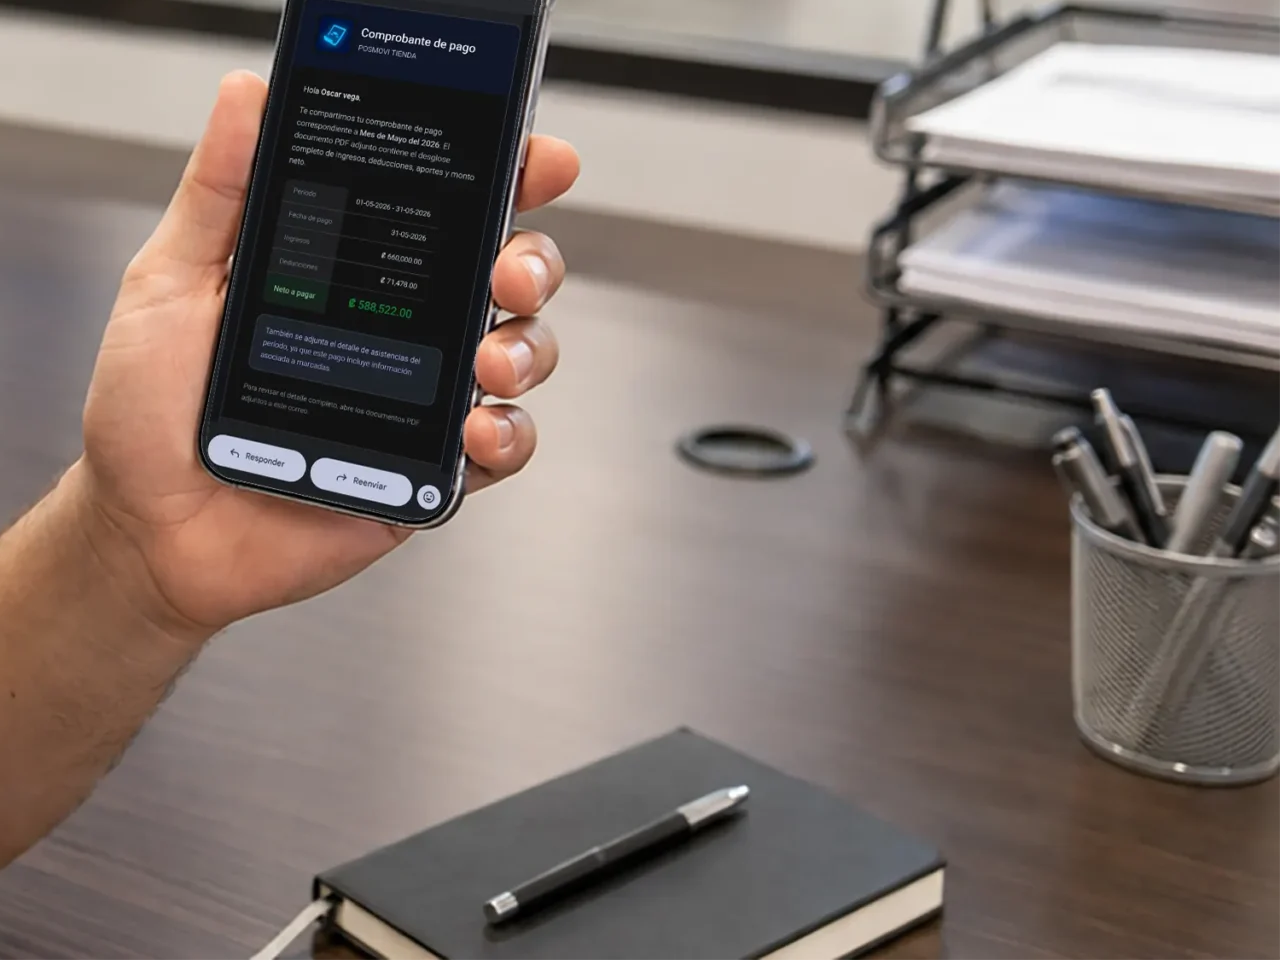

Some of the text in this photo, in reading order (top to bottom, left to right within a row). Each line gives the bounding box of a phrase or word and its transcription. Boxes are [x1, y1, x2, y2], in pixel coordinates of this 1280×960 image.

[361, 28, 476, 55] Comprobante de pago
[358, 44, 417, 59] POSMOVI TIENDA
[303, 85, 320, 95] Hola
[321, 88, 342, 99] Oscar
[300, 106, 443, 137] Te compartimos tu comprobante de pago
[296, 120, 353, 135] correspondiente
[359, 129, 375, 139] Mes
[376, 132, 386, 140] de
[387, 134, 407, 145] Mayo
[408, 137, 420, 146] del
[443, 142, 451, 150] El
[294, 132, 451, 164] documento PDF adjunto contiene el desglose
[291, 144, 475, 181] completo de ingresos, deducciones, aportes y monto
[355, 198, 390, 210] 01-05-2026
[395, 205, 431, 218] 31-05-2026
[316, 216, 333, 225] pago
[391, 229, 427, 242] 31-05-2026
[273, 285, 289, 295] Neto
[296, 290, 316, 300] pagar
[357, 300, 412, 319] 588,522.00
[260, 352, 290, 364] asociada
[304, 336, 329, 347] adjunta
[337, 342, 360, 352] detalle
[360, 346, 369, 355] de
[370, 349, 409, 363] asistencias
[409, 356, 421, 365] del
[290, 345, 298, 353] ya
[299, 348, 312, 356] que
[313, 350, 327, 359] este
[328, 353, 346, 363] pago
[346, 356, 370, 368] incluye
[371, 361, 412, 376] información
[243, 382, 258, 392] Para
[258, 385, 279, 396] revisar
[286, 392, 307, 402] detalle
[339, 404, 354, 413] abre
[355, 407, 364, 415] los
[365, 410, 406, 423] documentos
[406, 417, 421, 427] PDF
[245, 452, 285, 468] Responder
[352, 477, 387, 491] Reenviar
